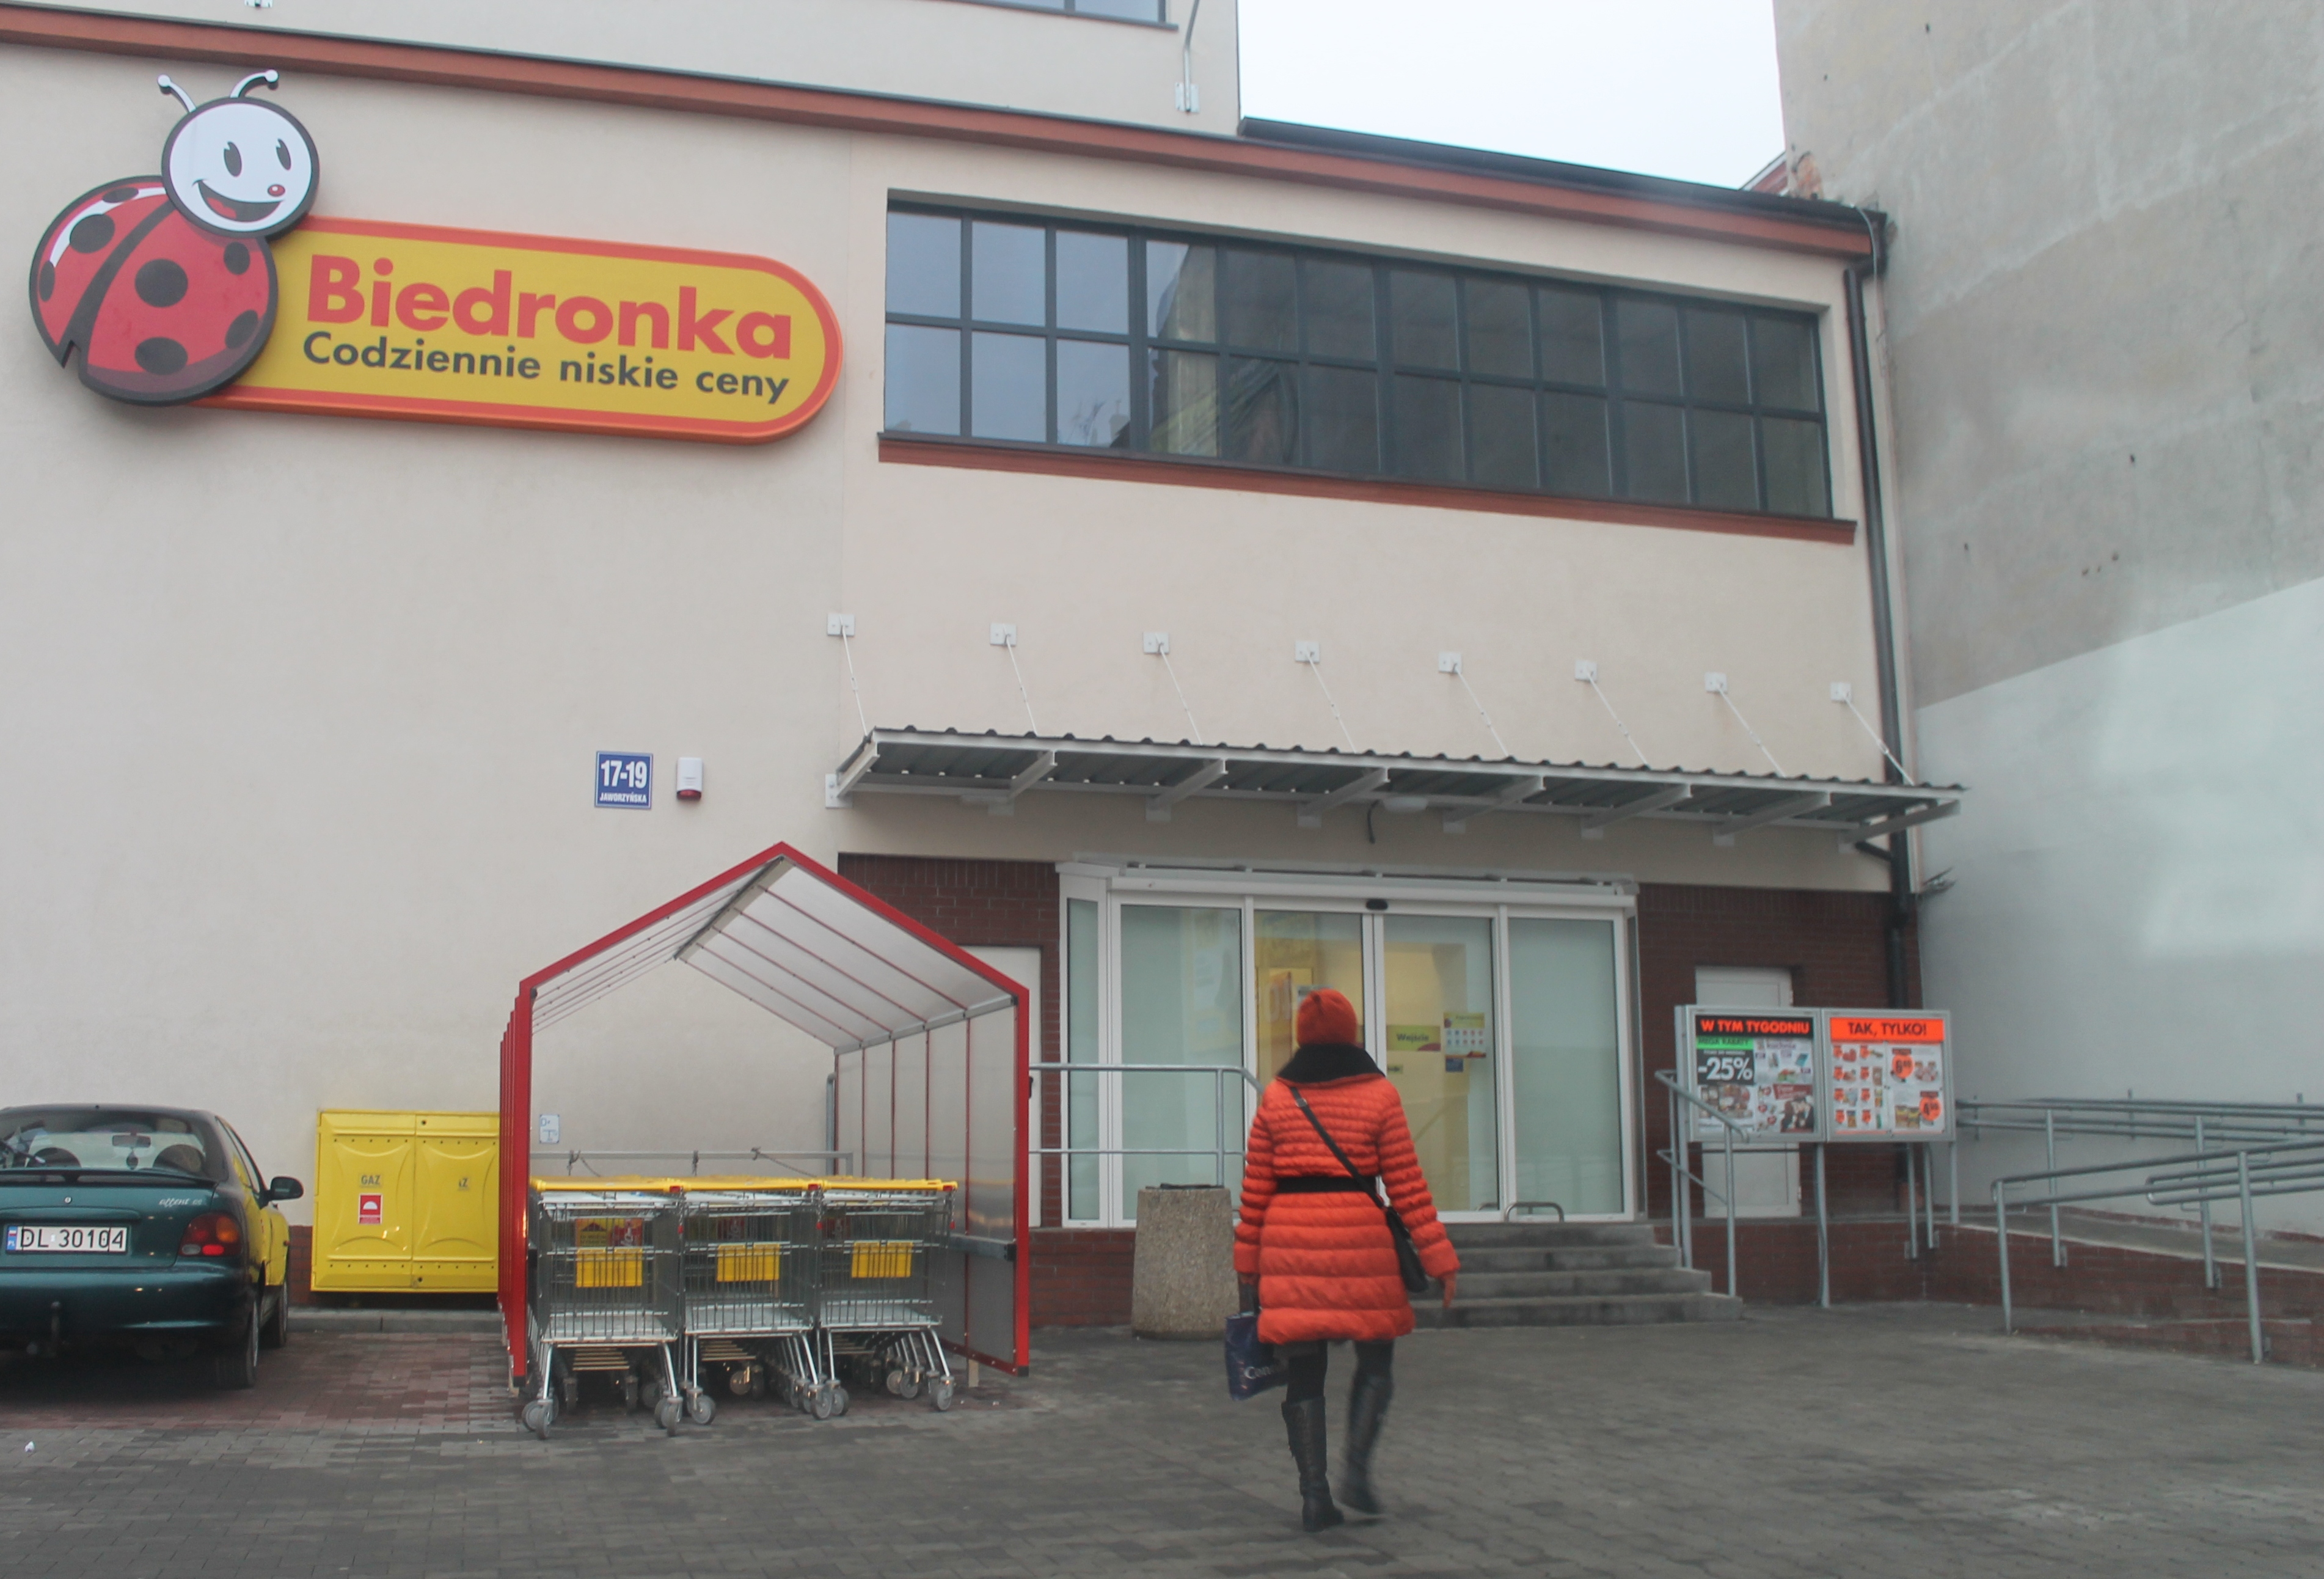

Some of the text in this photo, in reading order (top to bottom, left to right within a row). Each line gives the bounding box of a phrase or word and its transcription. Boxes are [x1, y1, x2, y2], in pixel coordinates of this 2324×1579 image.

[308, 255, 791, 359] Biedronka
[304, 332, 789, 404] Codziennie niskie ceny
[601, 760, 648, 789] 17-19
[599, 791, 647, 804] JAWORZYŃSKA
[1700, 1020, 1810, 1034] W TYM TYGODNIU
[1848, 1022, 1927, 1036] TAK, TYLKO!
[1698, 1057, 1753, 1081] -25%
[360, 1174, 381, 1185] GAZ
[20, 1228, 124, 1249] DL 30104
